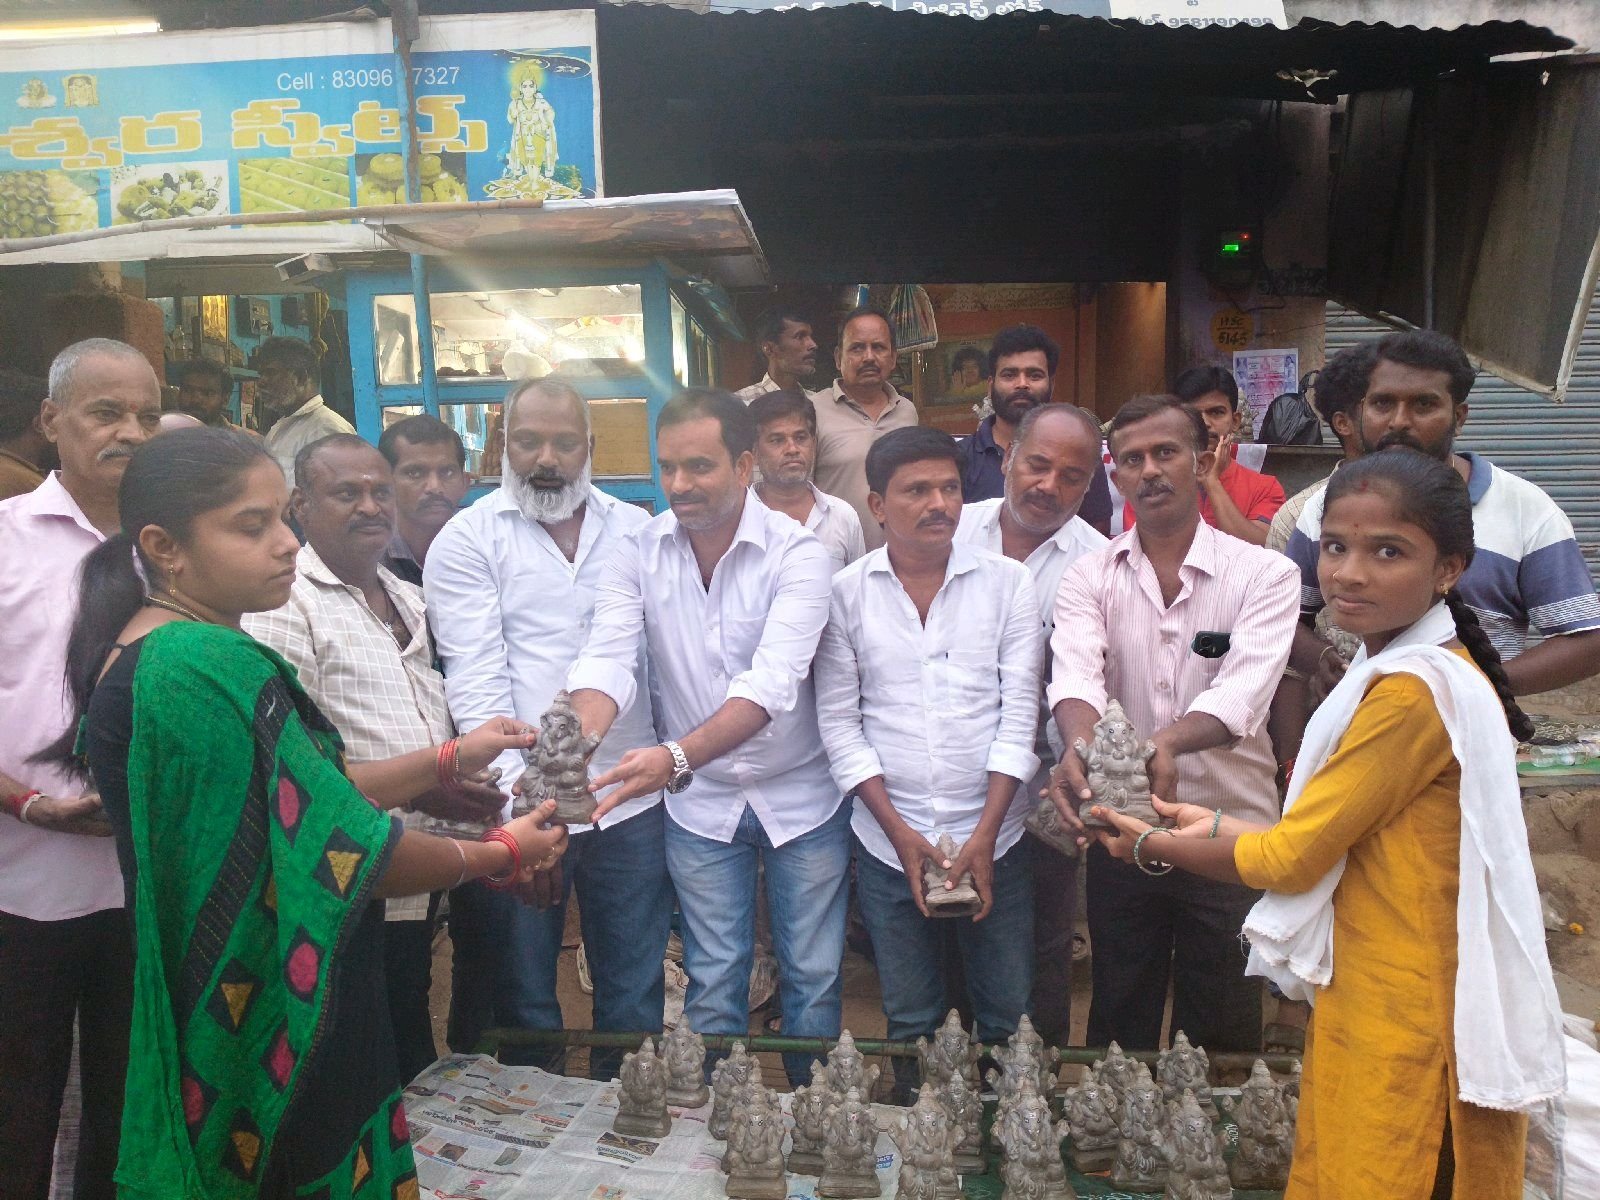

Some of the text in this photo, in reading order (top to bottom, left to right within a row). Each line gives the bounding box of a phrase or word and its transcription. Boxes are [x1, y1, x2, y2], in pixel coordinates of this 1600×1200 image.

[277, 71, 314, 92] Cell
[332, 68, 393, 89] 83096
[413, 66, 460, 86] 7327
